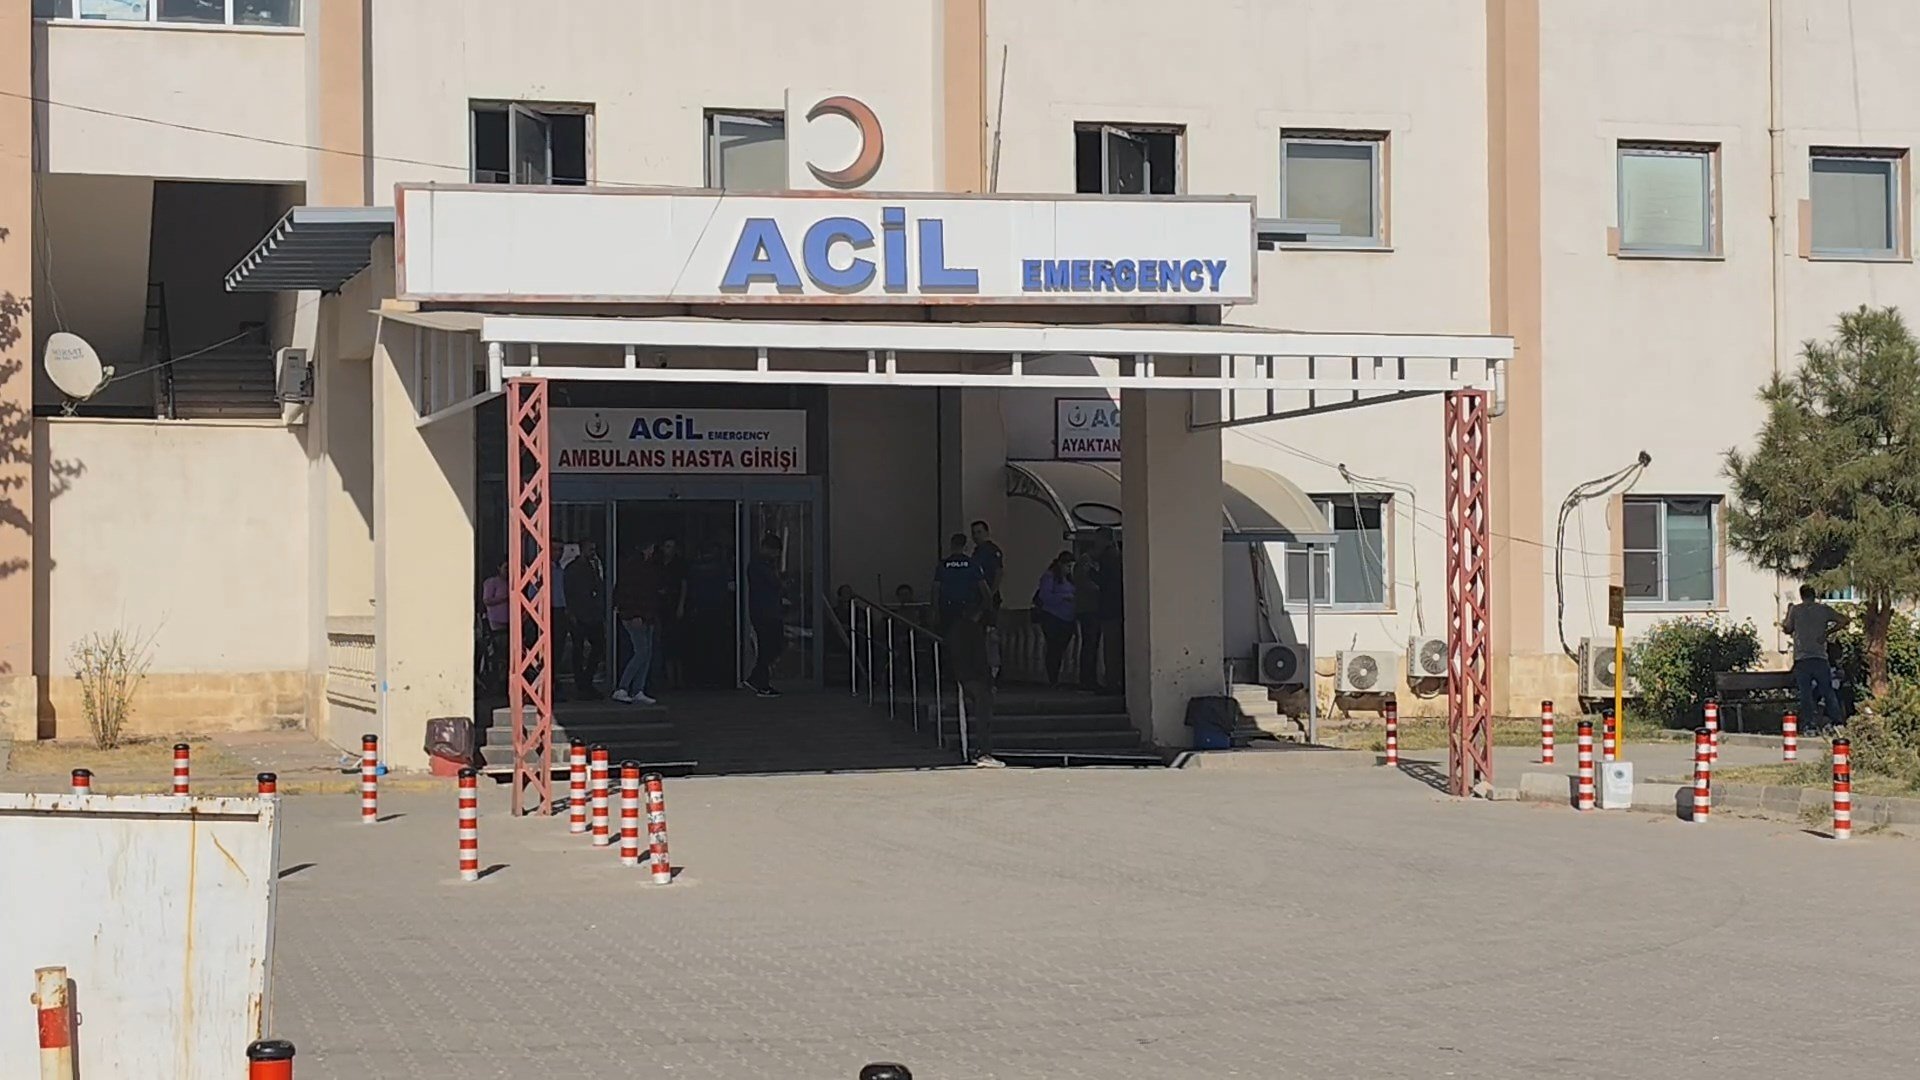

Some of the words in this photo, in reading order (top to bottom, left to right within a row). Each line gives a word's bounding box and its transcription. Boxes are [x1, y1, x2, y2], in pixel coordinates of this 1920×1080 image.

[720, 206, 979, 294] ACİL
[1021, 258, 1227, 292] EMERGENCY
[628, 414, 704, 440] ACİL
[708, 431, 770, 441] EMERGENCY
[1062, 438, 1121, 452] AYAKTAN
[558, 449, 666, 468] AMBULANS
[671, 449, 735, 468] HASTA
[740, 446, 797, 472] GİRİŞİ
